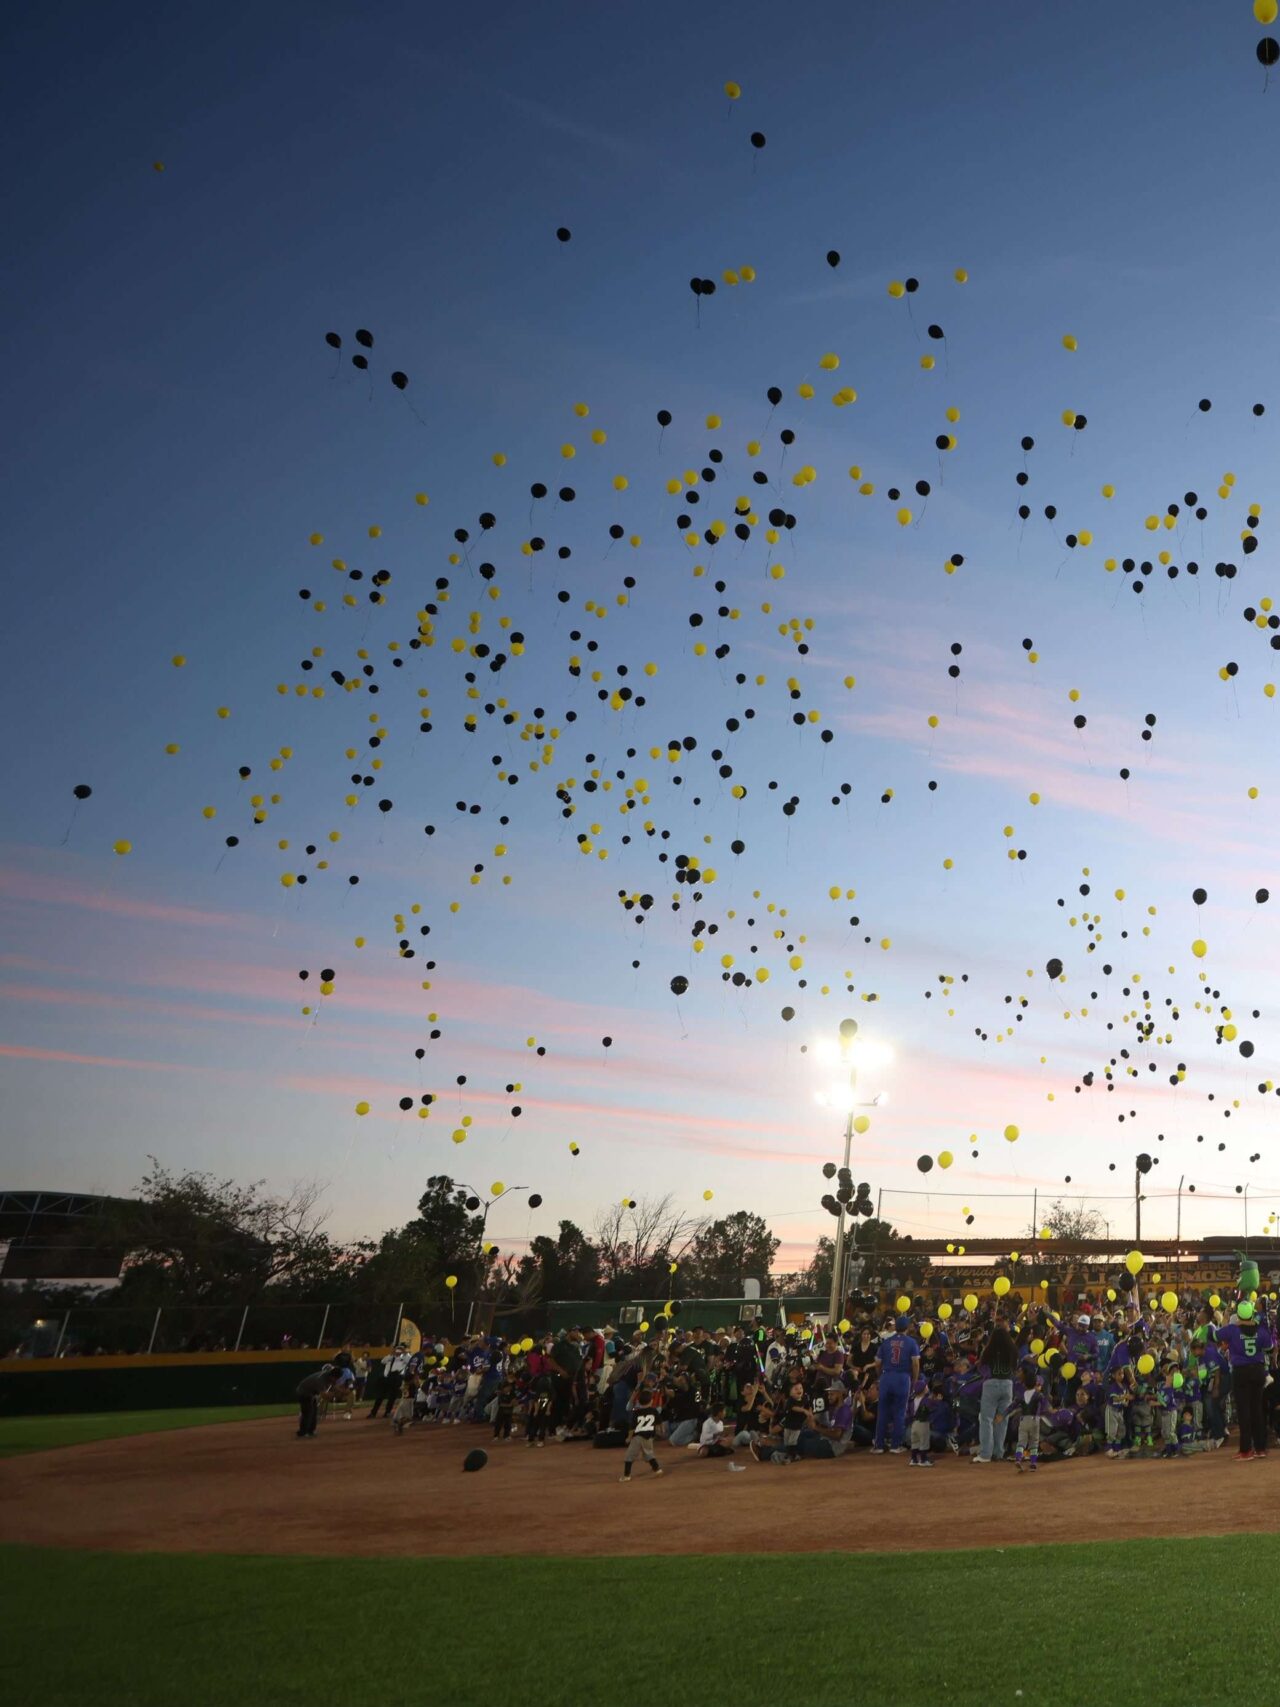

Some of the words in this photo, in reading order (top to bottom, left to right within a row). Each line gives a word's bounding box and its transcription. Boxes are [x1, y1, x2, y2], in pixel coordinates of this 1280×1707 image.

[1244, 1339, 1257, 1357] 5
[812, 1397, 825, 1413] 19
[634, 1413, 656, 1434] 22
